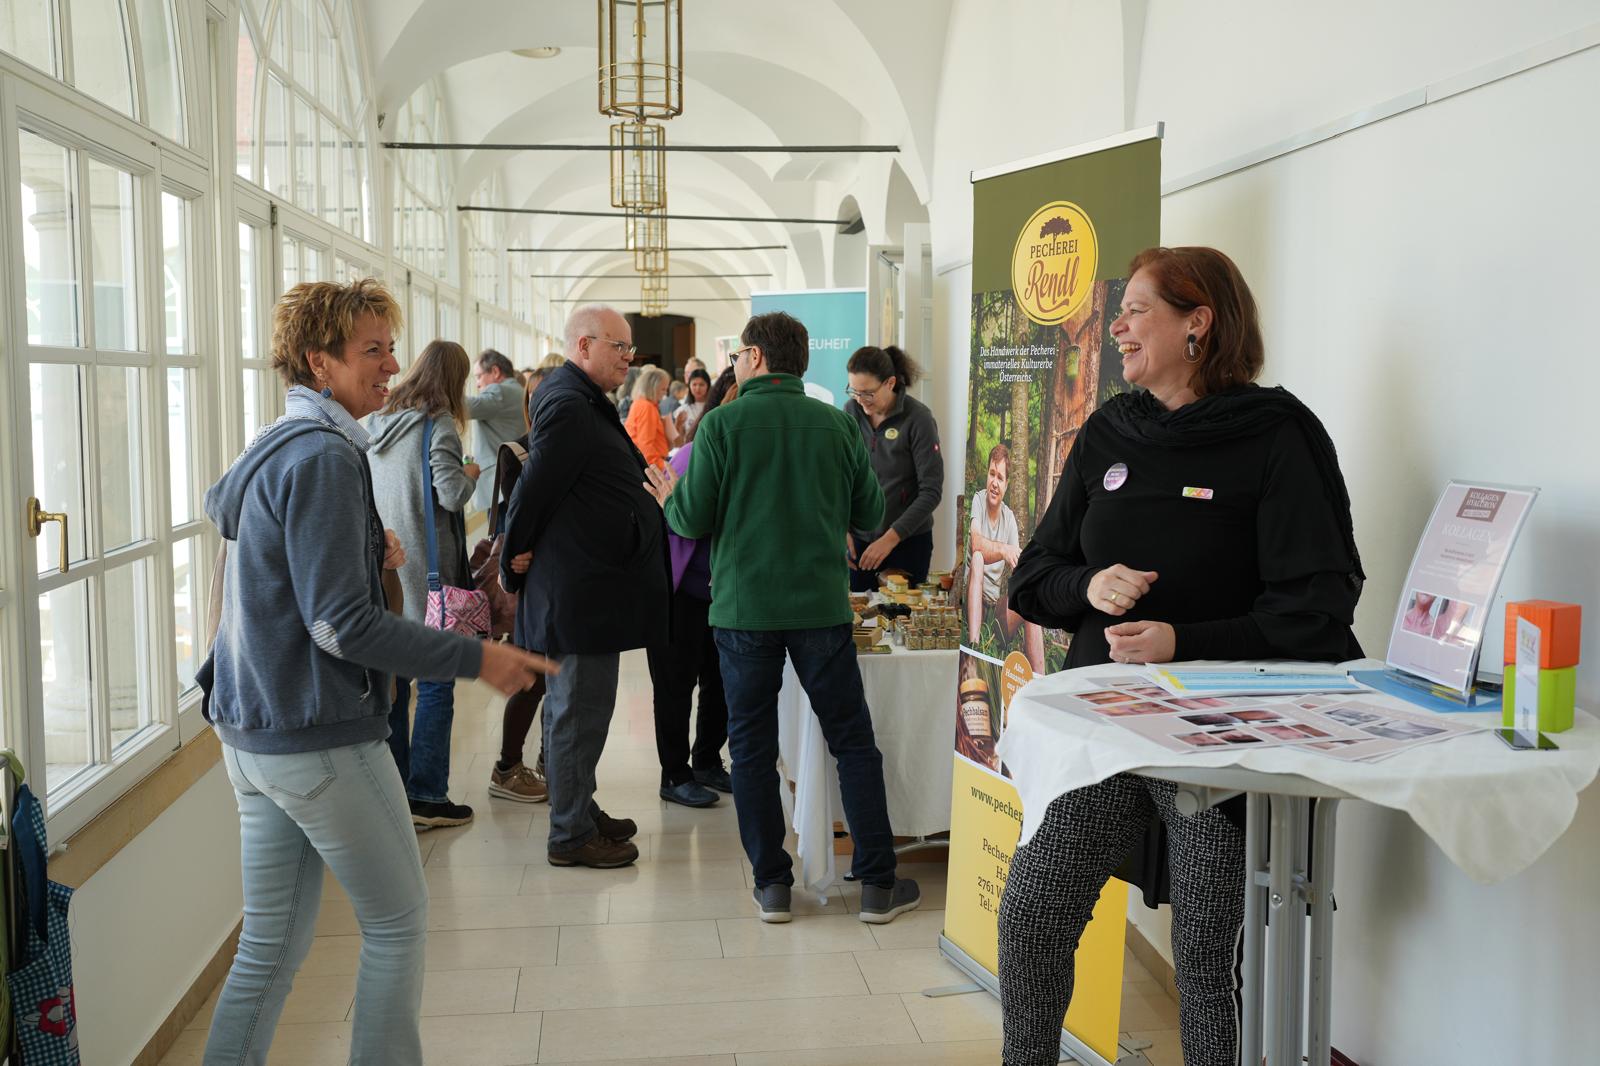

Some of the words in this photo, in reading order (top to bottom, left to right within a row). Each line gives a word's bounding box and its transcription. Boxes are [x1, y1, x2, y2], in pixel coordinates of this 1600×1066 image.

[1030, 239, 1079, 259] PECHEREI
[1024, 256, 1080, 313] Rendl
[808, 338, 851, 350] EUHEIT
[980, 346, 990, 357] Das
[990, 345, 1019, 357] Handwerk
[1020, 344, 1029, 356] der
[1030, 344, 1056, 356] Pecherei
[984, 358, 1020, 369] immaterielles
[1021, 357, 1053, 369] Kulturerbe
[970, 785, 1024, 823] www.pecher
[982, 837, 1012, 866] Pechere
[995, 865, 1007, 883] Ha
[977, 875, 994, 896] 2761
